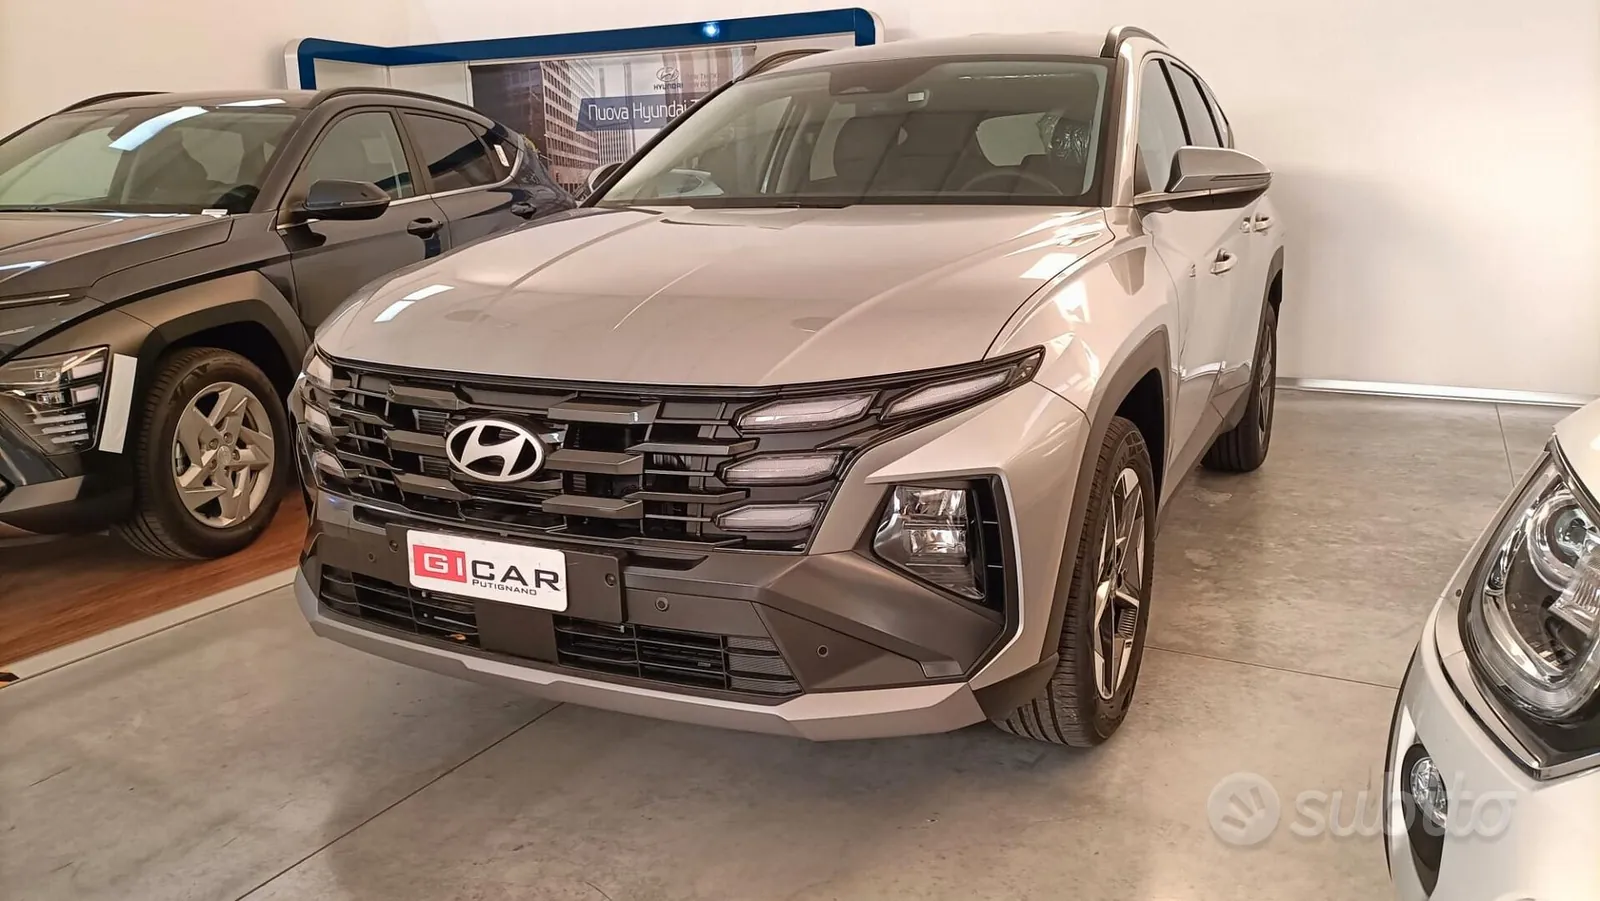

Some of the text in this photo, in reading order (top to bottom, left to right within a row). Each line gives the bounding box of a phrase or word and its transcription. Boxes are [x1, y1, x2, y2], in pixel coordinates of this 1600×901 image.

[653, 82, 683, 91] HYUNDAI
[588, 99, 687, 122] Nuova Hyundai
[472, 579, 537, 596] PUTIGNANO
